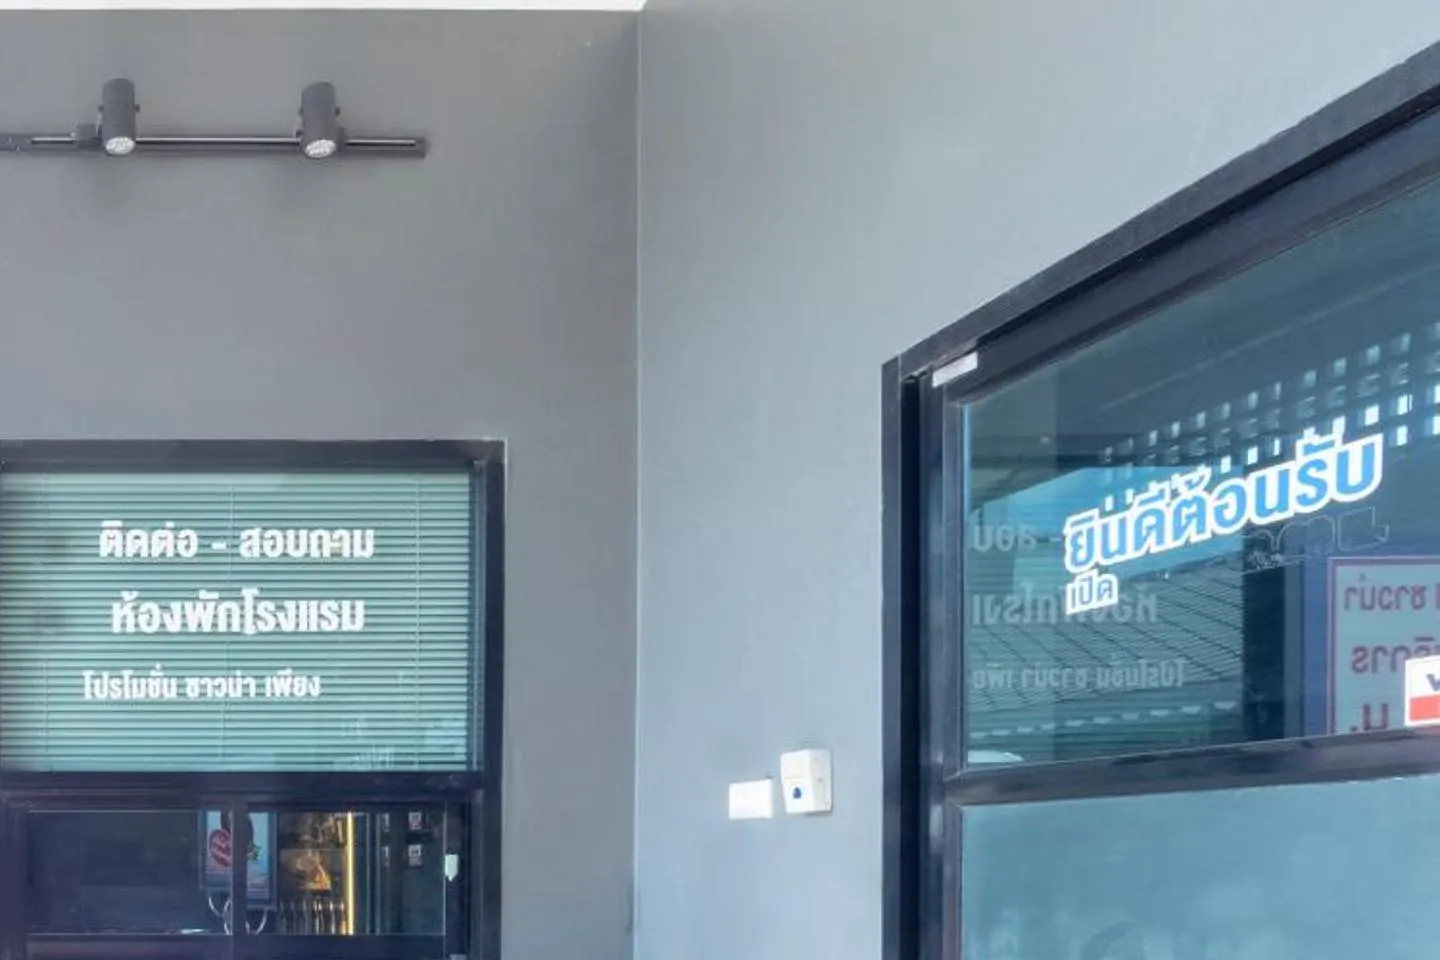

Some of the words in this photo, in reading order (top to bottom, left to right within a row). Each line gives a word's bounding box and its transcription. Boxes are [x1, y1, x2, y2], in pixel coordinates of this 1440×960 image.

[1064, 432, 1384, 573] ยินดีต้อนรับ
[99, 520, 199, 558] ติดต่อ
[239, 525, 375, 559] สอบถาม
[111, 587, 365, 635] ห้องพักโรงแรม
[82, 663, 178, 700] โปรโมชั่น
[186, 670, 257, 699] ซาวน่า
[266, 668, 321, 698] เพียง
